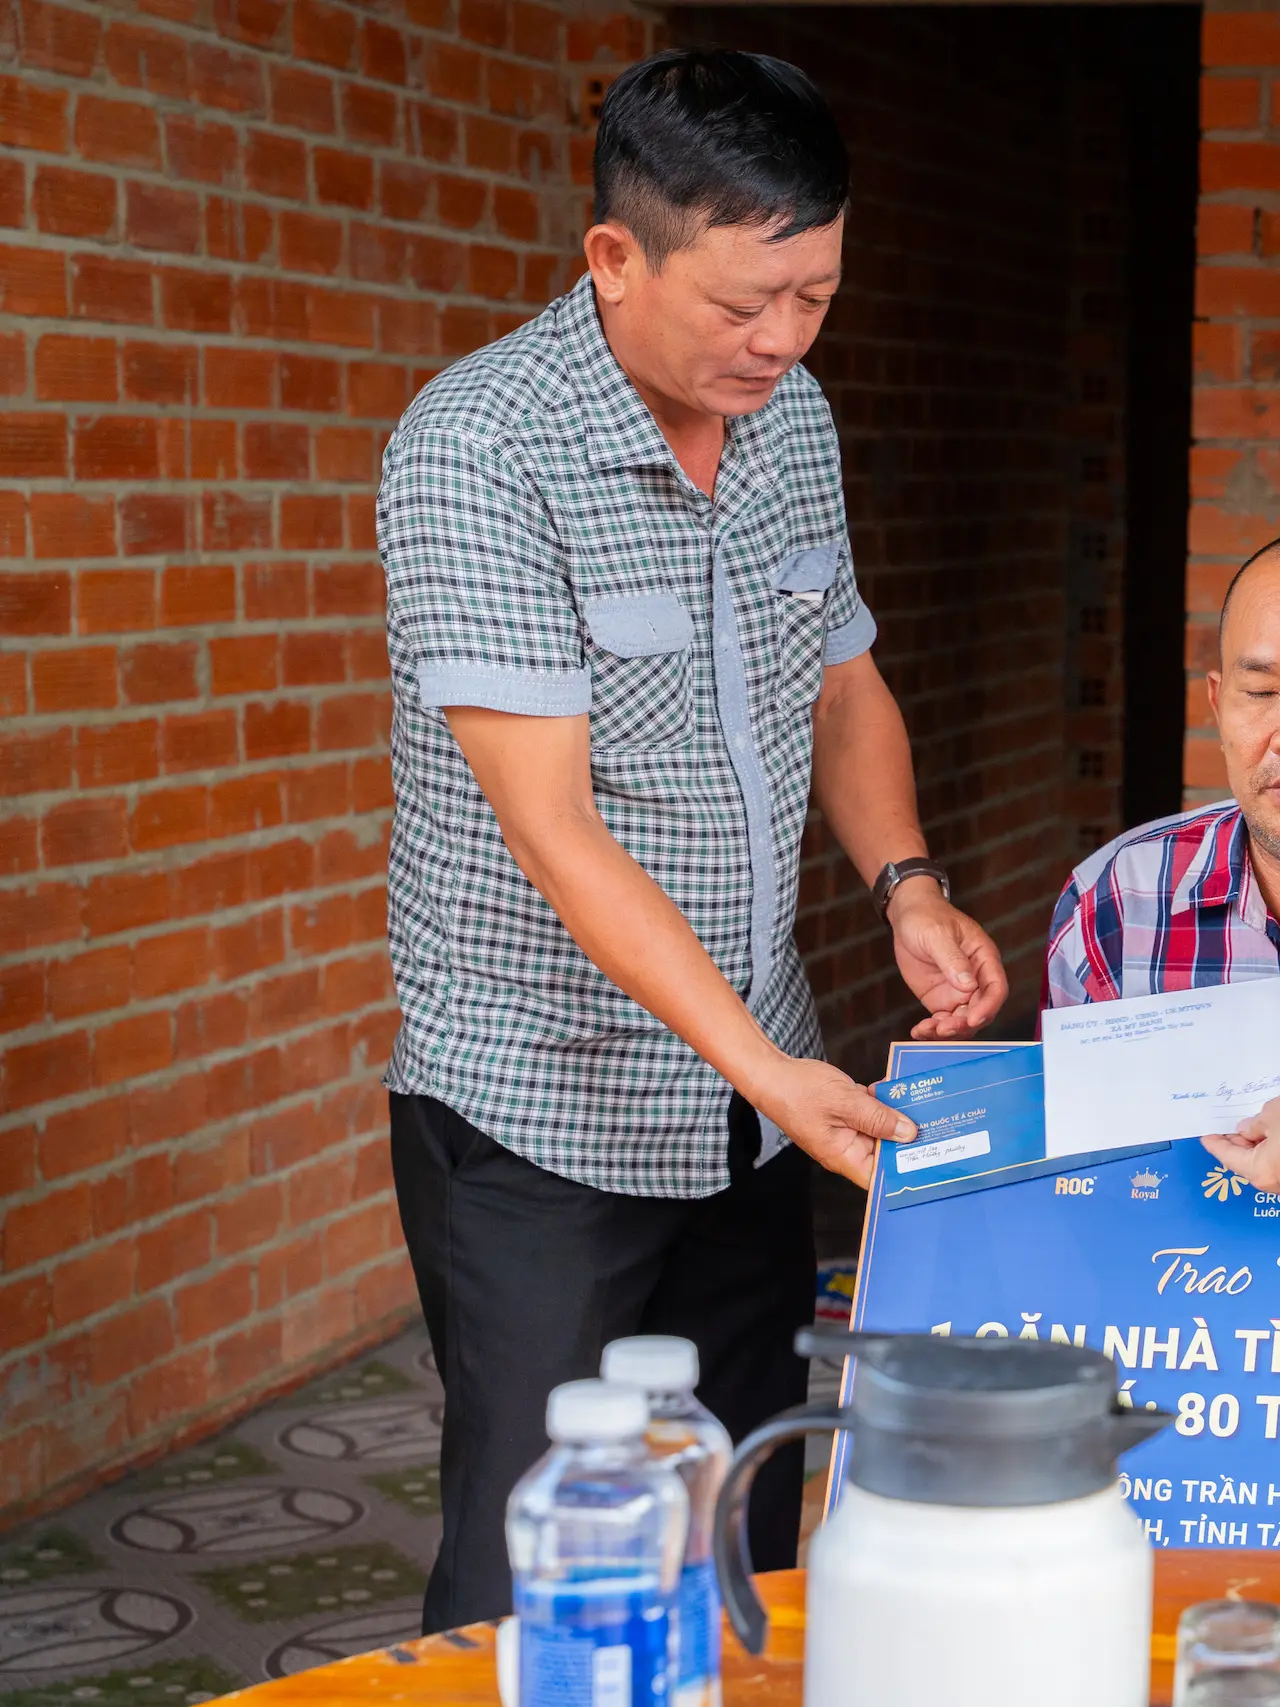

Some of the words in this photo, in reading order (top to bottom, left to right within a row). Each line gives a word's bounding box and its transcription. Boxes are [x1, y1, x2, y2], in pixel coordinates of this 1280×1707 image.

[910, 1086, 932, 1096] GROUP
[1055, 1177, 1094, 1195] ROC
[1131, 1188, 1159, 1201] Royal
[1151, 1245, 1252, 1295] Trao
[1103, 1317, 1219, 1371] NHÀ
[1175, 1392, 1240, 1437] 80
[1182, 1474, 1258, 1505] TRẦN
[1180, 1513, 1248, 1545] TỈNH
